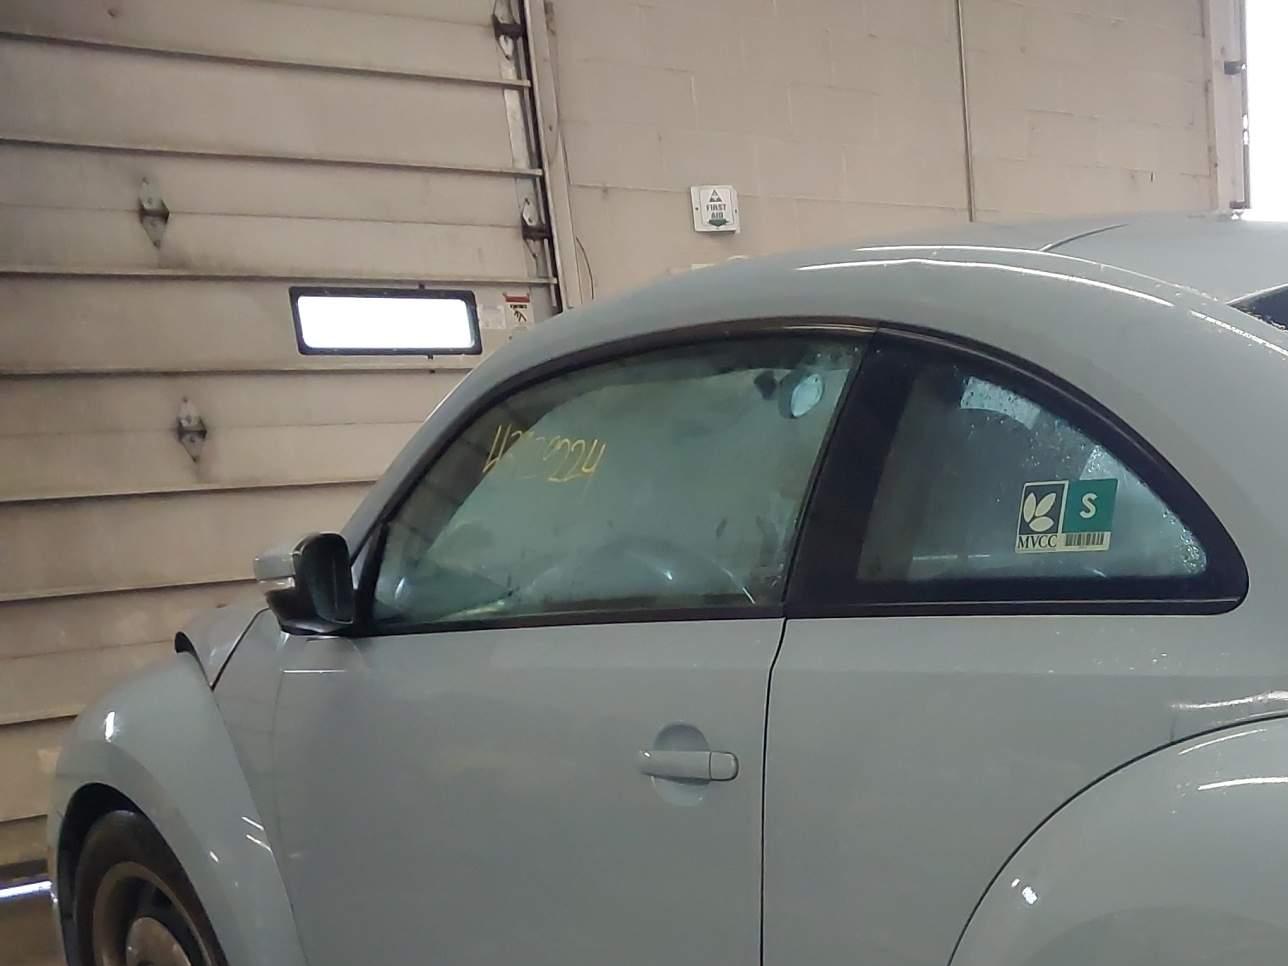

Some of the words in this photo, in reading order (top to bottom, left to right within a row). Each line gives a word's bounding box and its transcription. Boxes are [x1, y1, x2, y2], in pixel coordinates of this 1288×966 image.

[706, 203, 726, 211] FIRST
[711, 211, 724, 219] AID
[1080, 493, 1098, 519] S
[1017, 534, 1058, 549] MVCC
